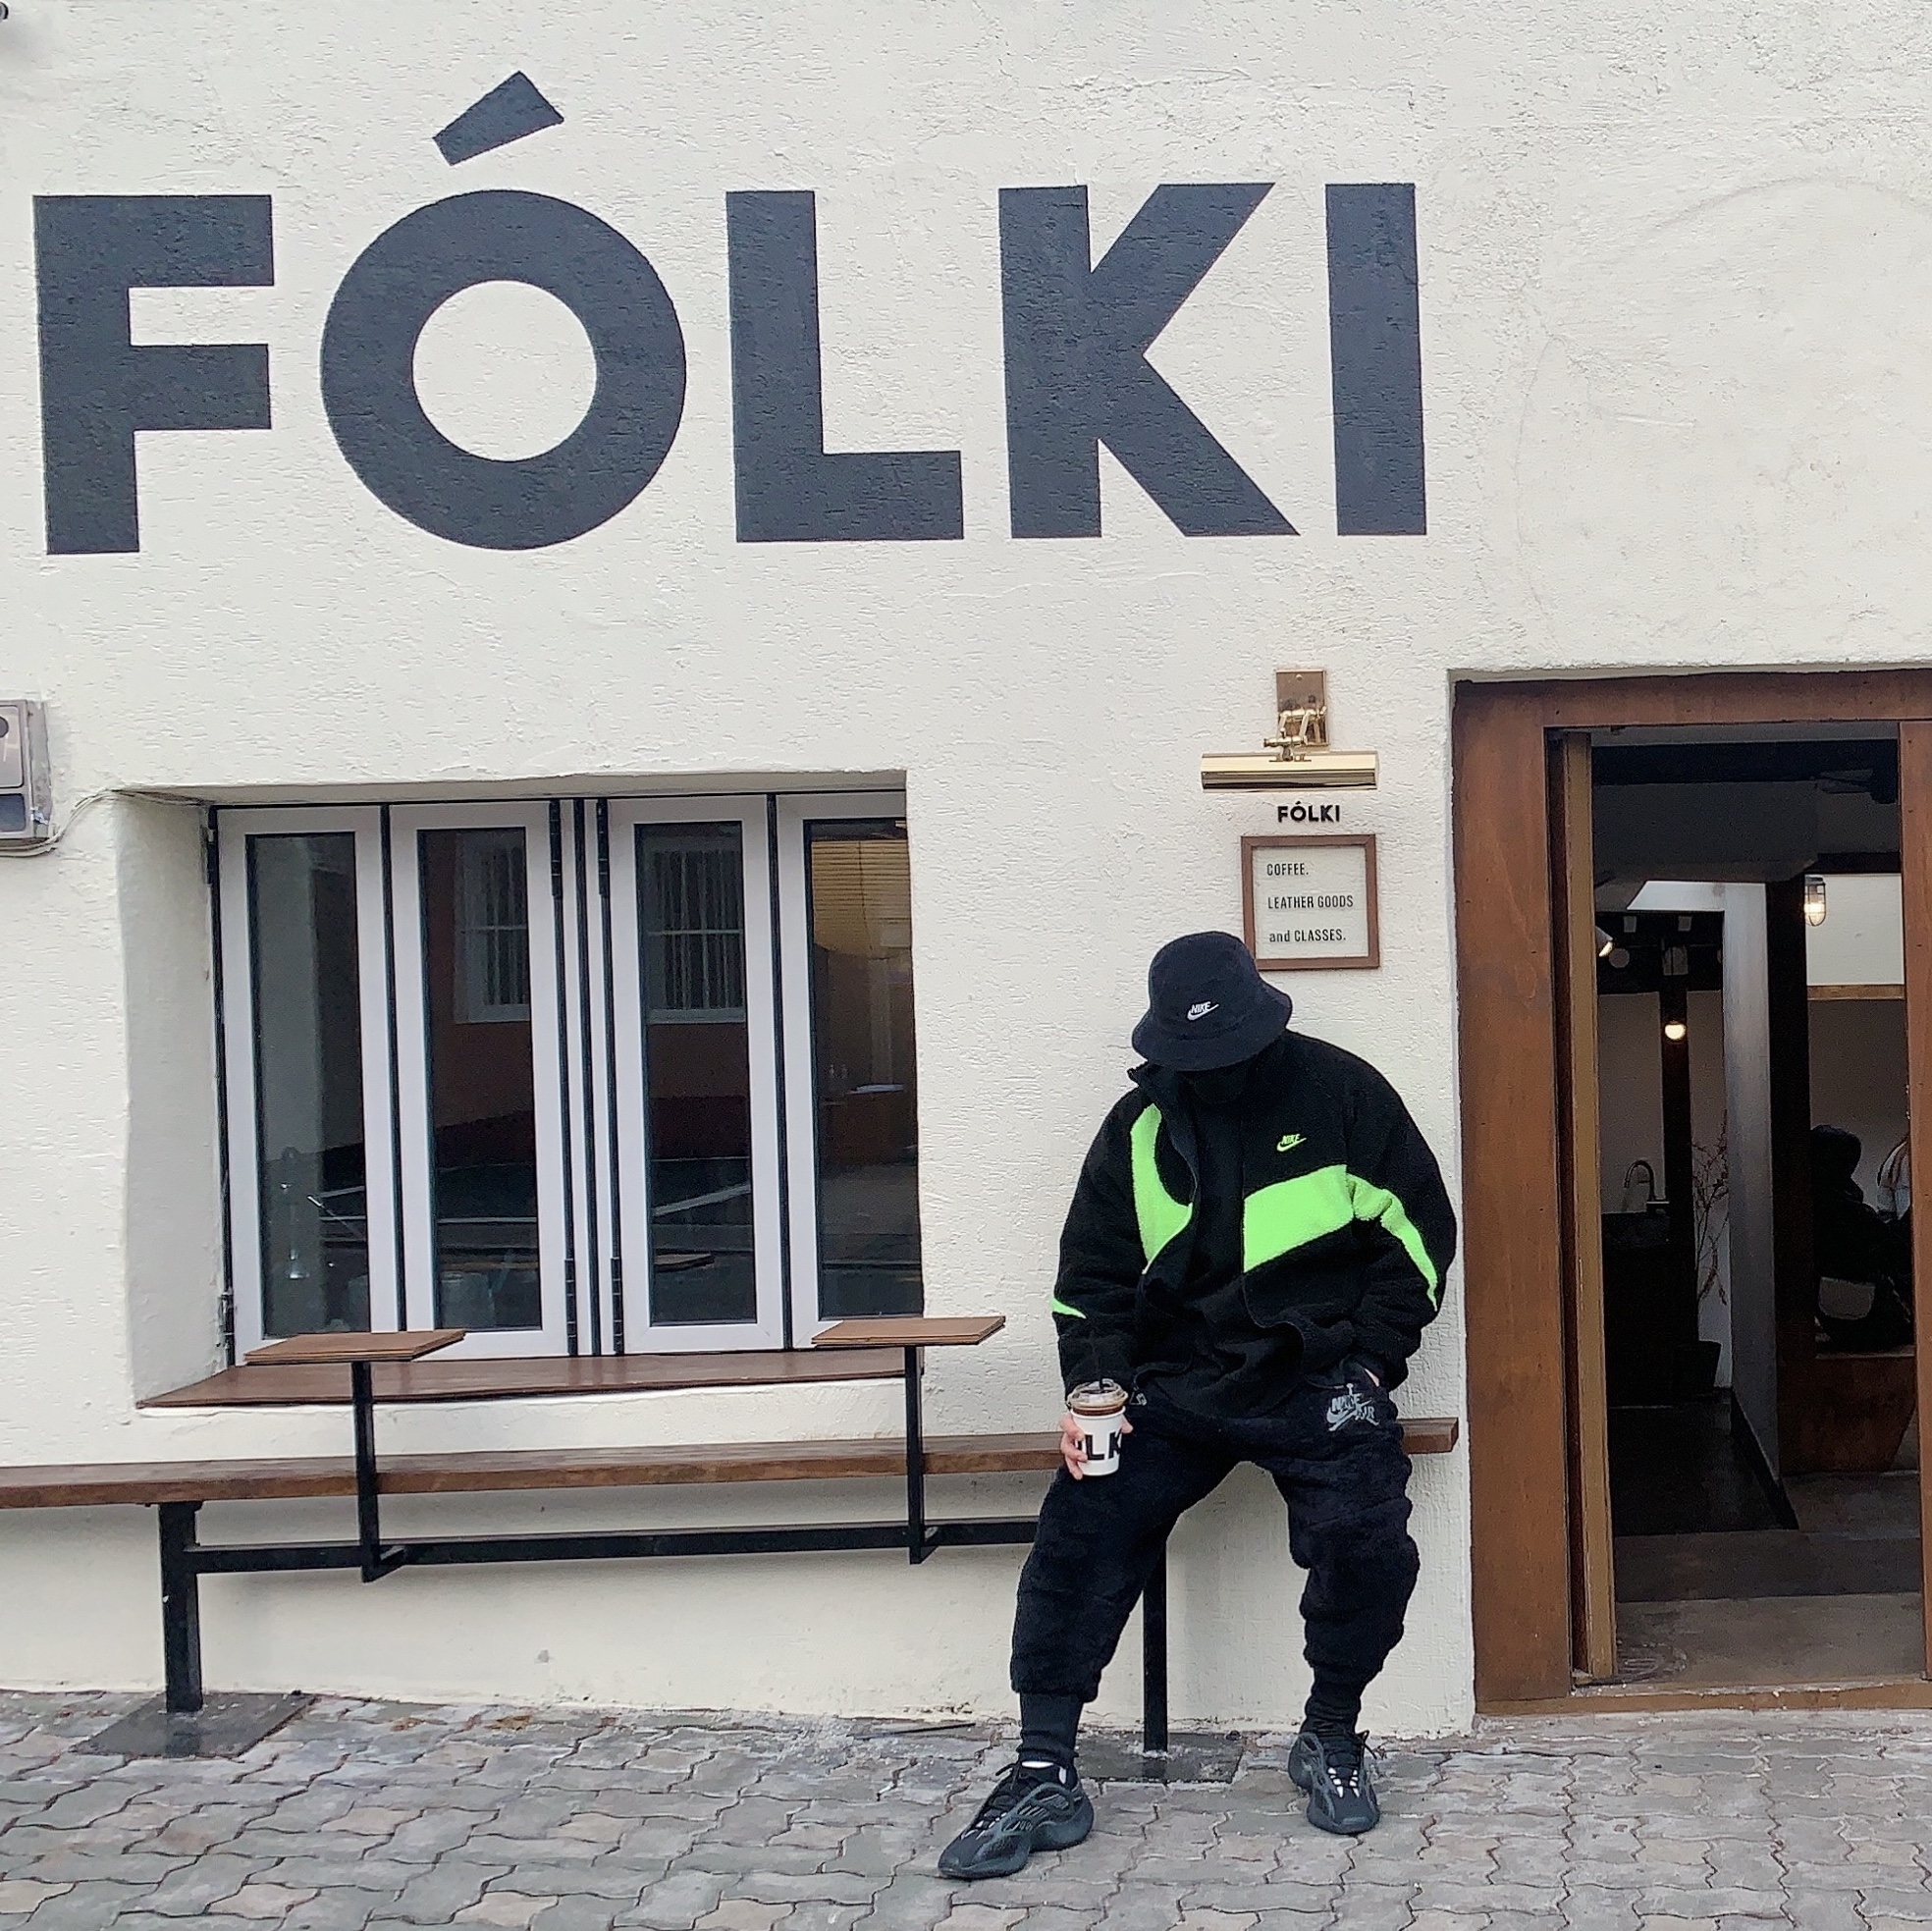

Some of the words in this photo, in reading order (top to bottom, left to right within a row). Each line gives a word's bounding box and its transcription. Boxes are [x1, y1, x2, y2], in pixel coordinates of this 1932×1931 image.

[32, 71, 1426, 554] FÓLKI
[1277, 800, 1340, 823] FÓLKI
[1266, 863, 1309, 876] COFFEE.
[1267, 895, 1315, 909] LEATHER
[1317, 895, 1354, 908] GOODS
[1268, 929, 1290, 942] and
[1294, 929, 1346, 942] CLASSES.
[1078, 1431, 1122, 1461] LK
